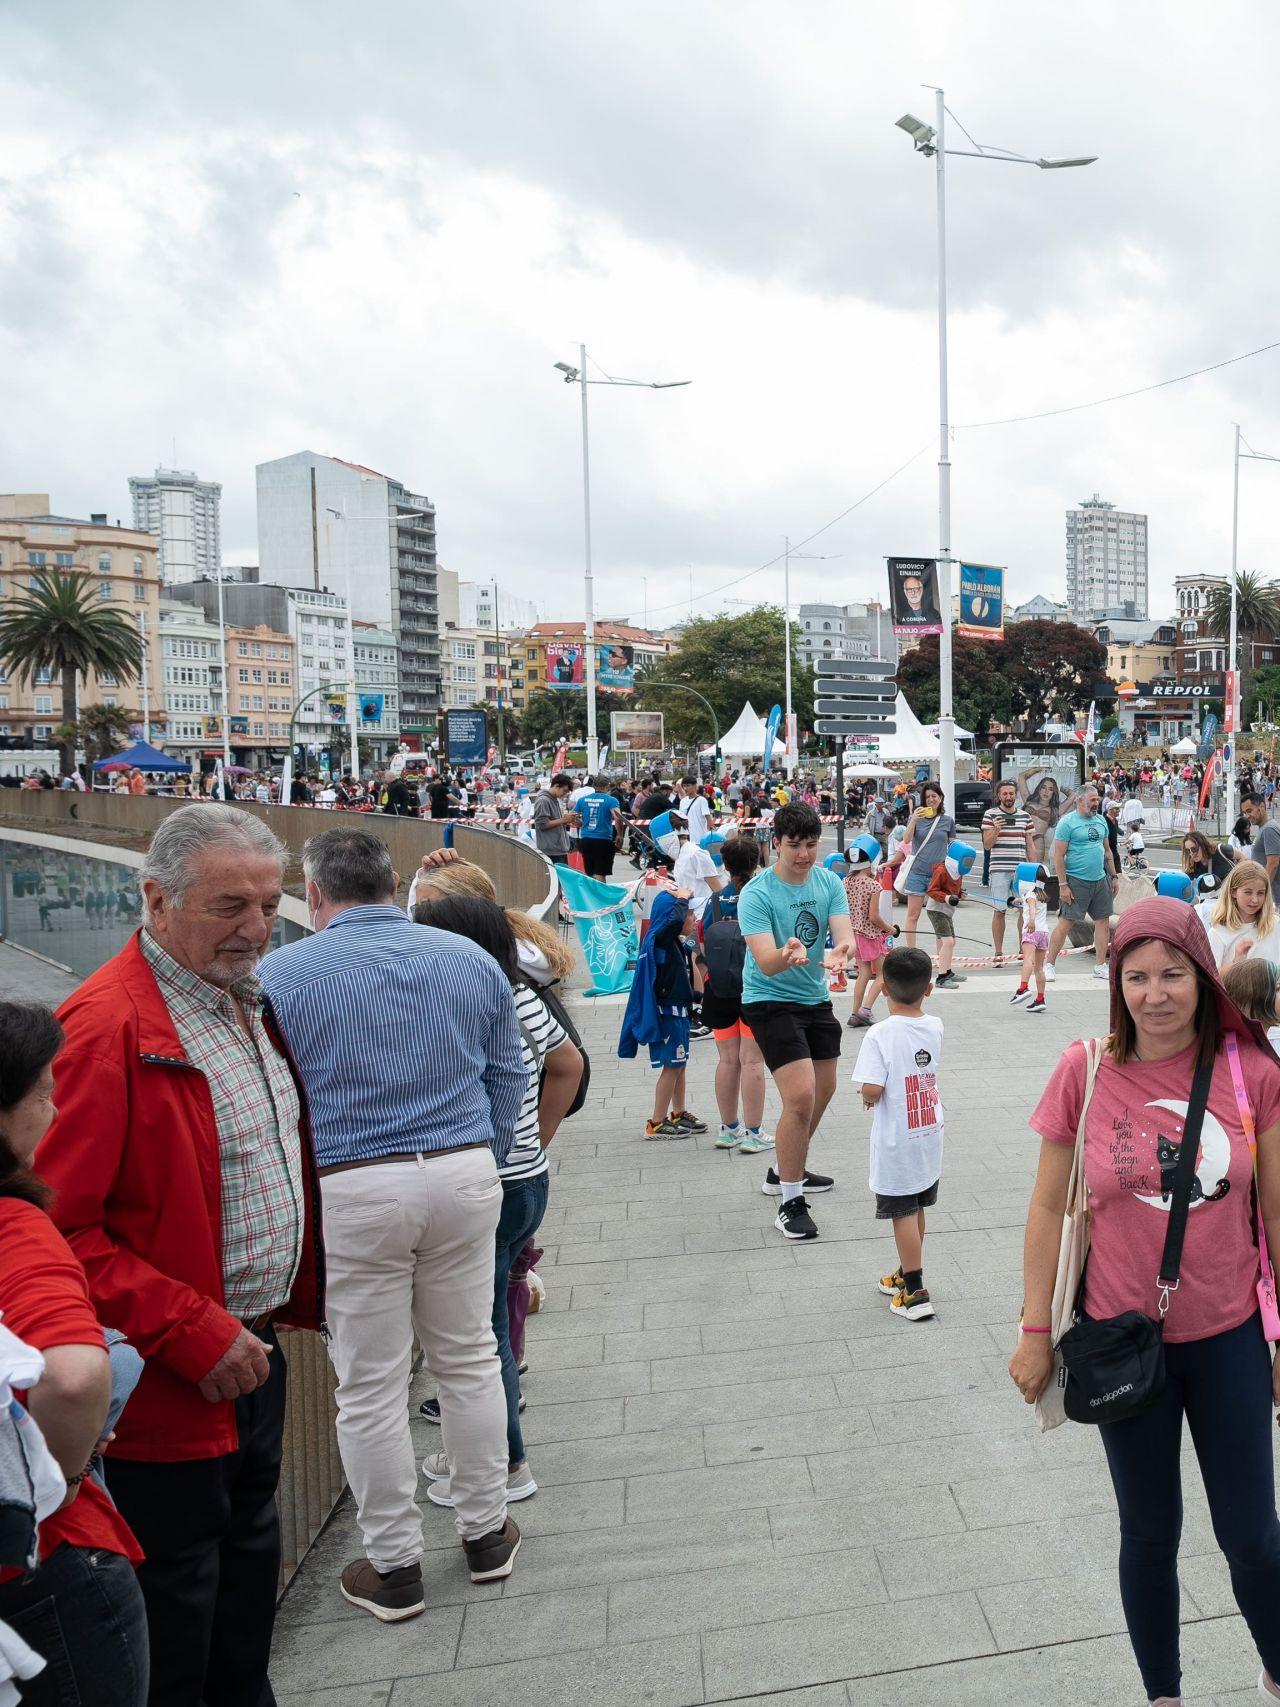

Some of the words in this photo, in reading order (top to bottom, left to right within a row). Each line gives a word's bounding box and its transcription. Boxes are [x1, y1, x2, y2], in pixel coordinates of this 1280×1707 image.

[961, 581, 977, 590] PABLO
[1152, 686, 1211, 695] REPSOL
[321, 752, 328, 760] P
[906, 1092, 919, 1111] DO
[908, 1110, 920, 1129] NA
[921, 1106, 937, 1127] RUA
[1112, 1117, 1133, 1130] Love
[1116, 1130, 1133, 1145] you
[1109, 1143, 1118, 1153] to
[1121, 1141, 1136, 1153] the
[1111, 1151, 1138, 1166] Moon
[1115, 1163, 1134, 1175] and
